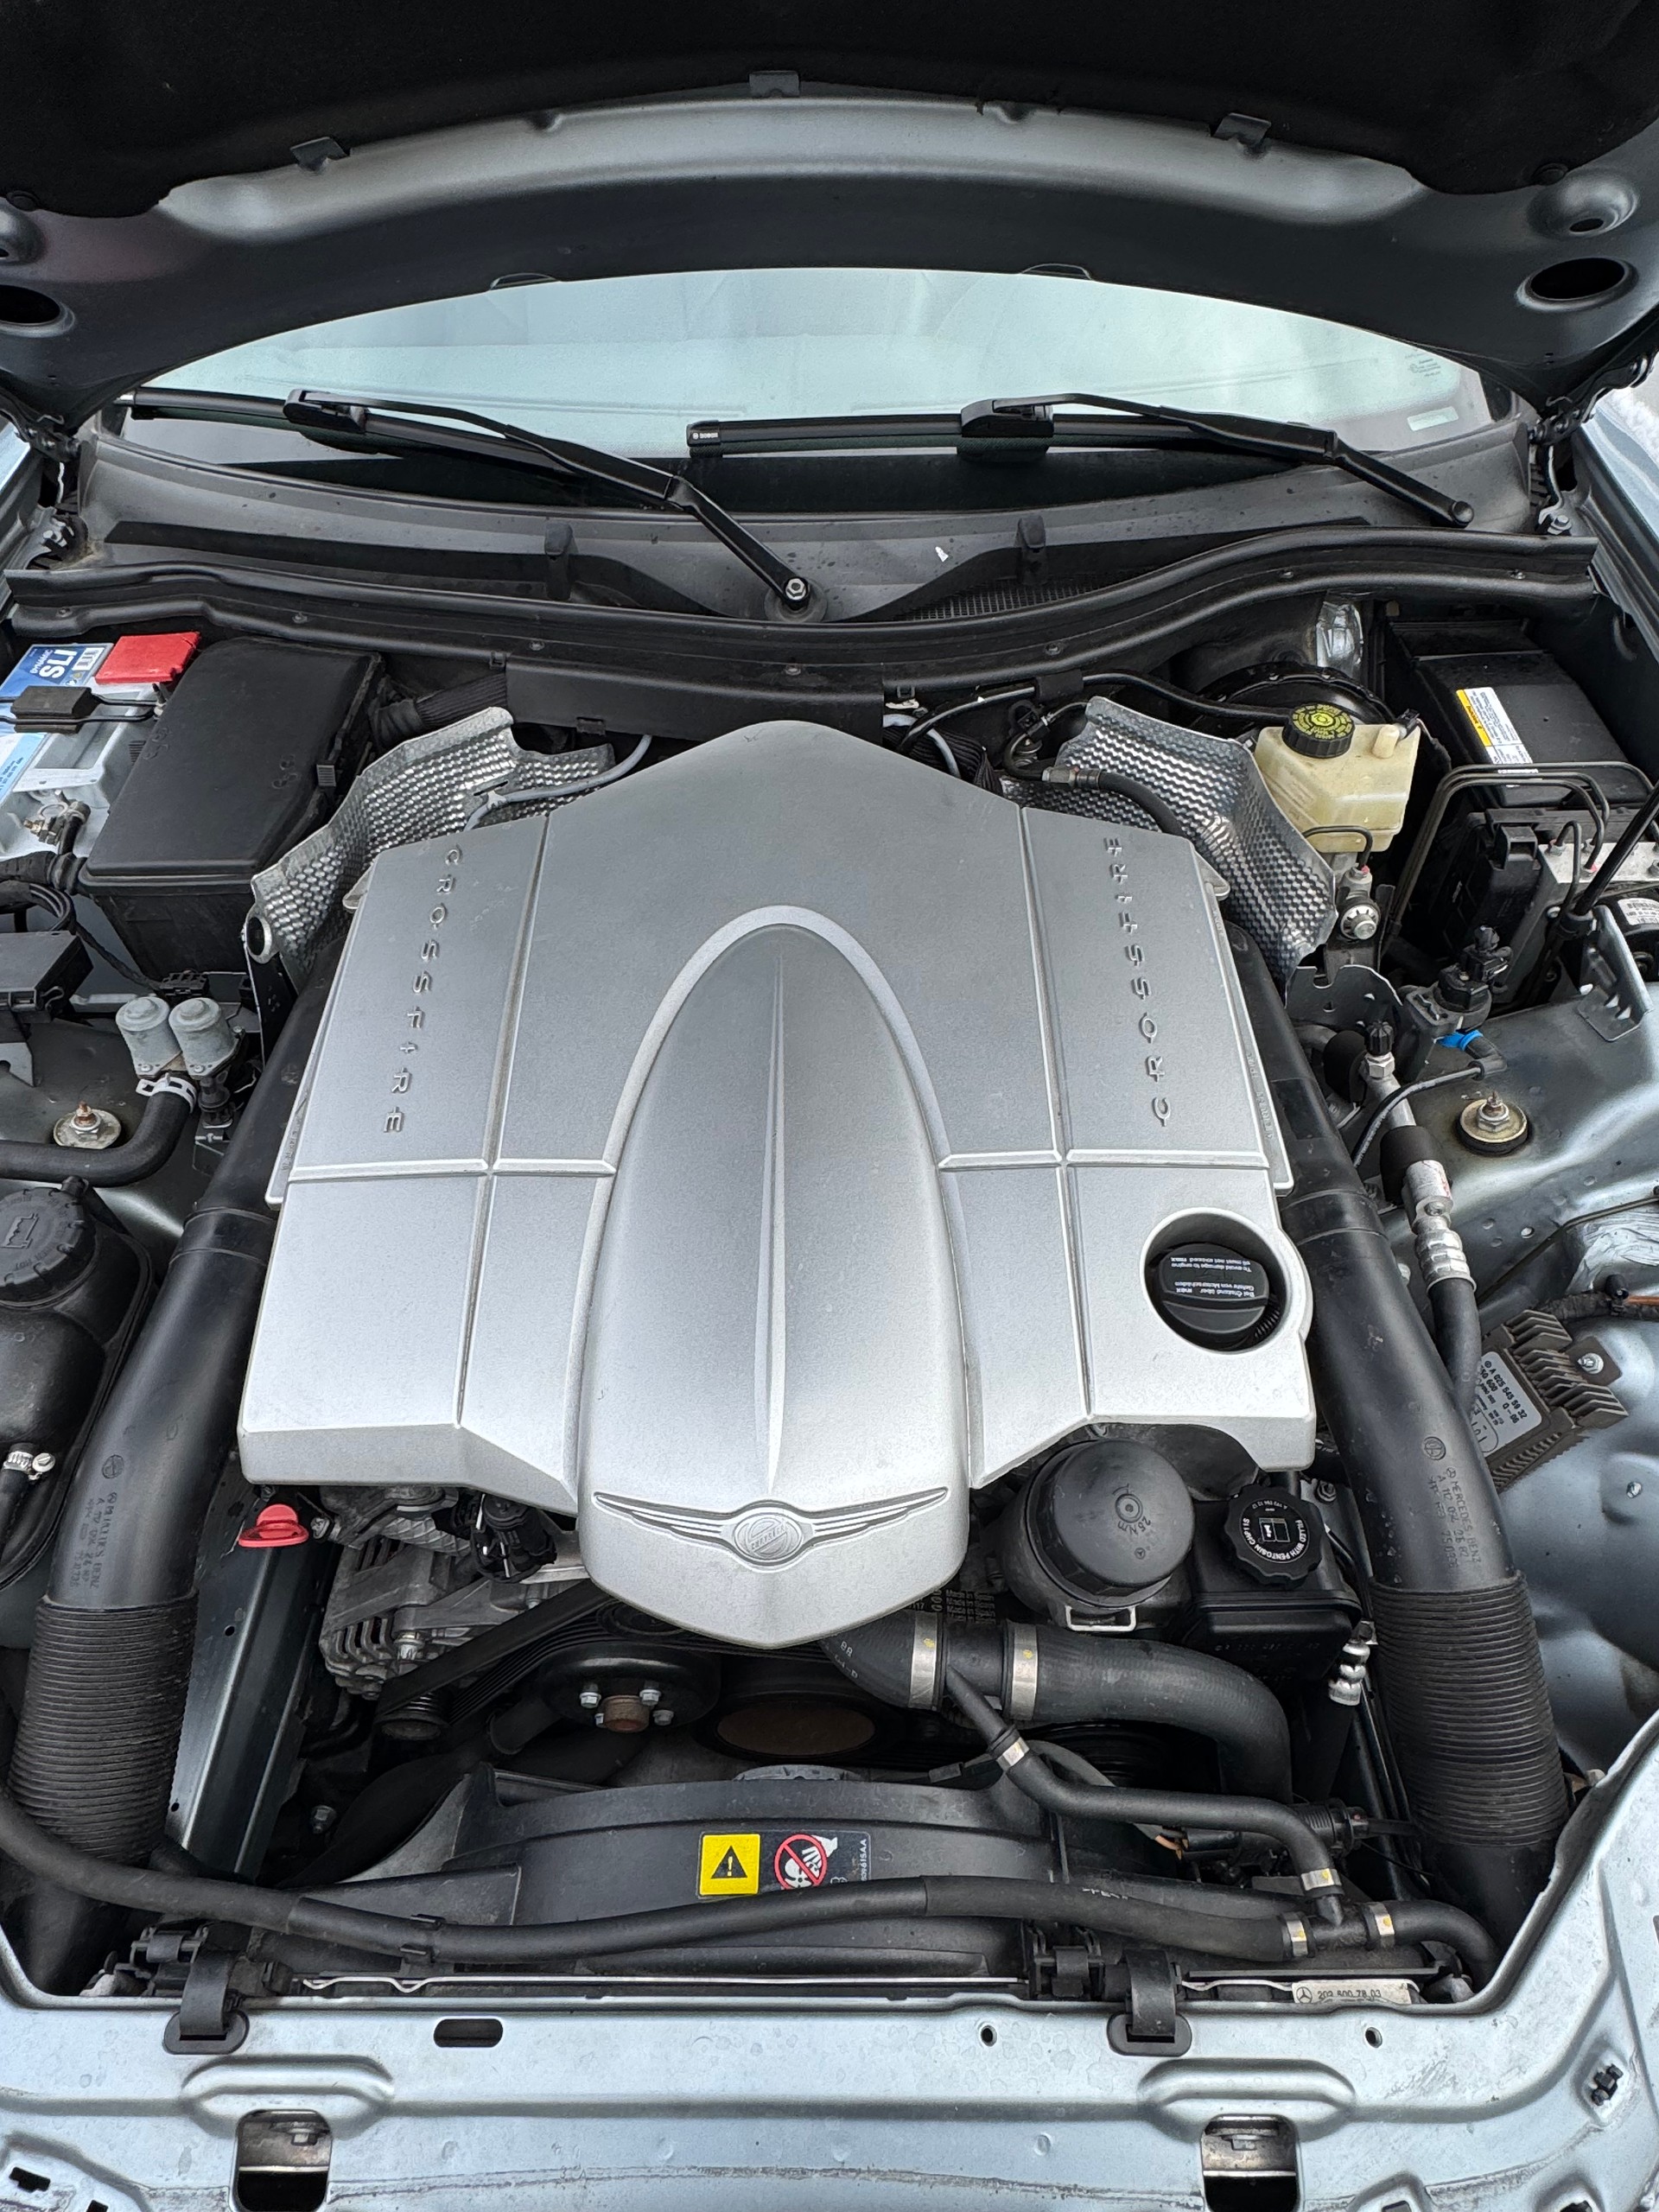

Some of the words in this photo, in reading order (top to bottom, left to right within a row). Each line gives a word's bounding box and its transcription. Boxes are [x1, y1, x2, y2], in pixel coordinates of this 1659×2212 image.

[39, 650, 78, 678] SLI
[383, 845, 462, 1134] CROSSFIRE
[1103, 836, 1171, 1126] CROSSFIRE
[1451, 1480, 1472, 1532] MERCEDES
[751, 1525, 787, 1550] CHRYSLER
[1295, 1520, 1306, 1543] FILLED
[1254, 1546, 1291, 1560] PENTOSIN
[1290, 1543, 1305, 1556] WITH
